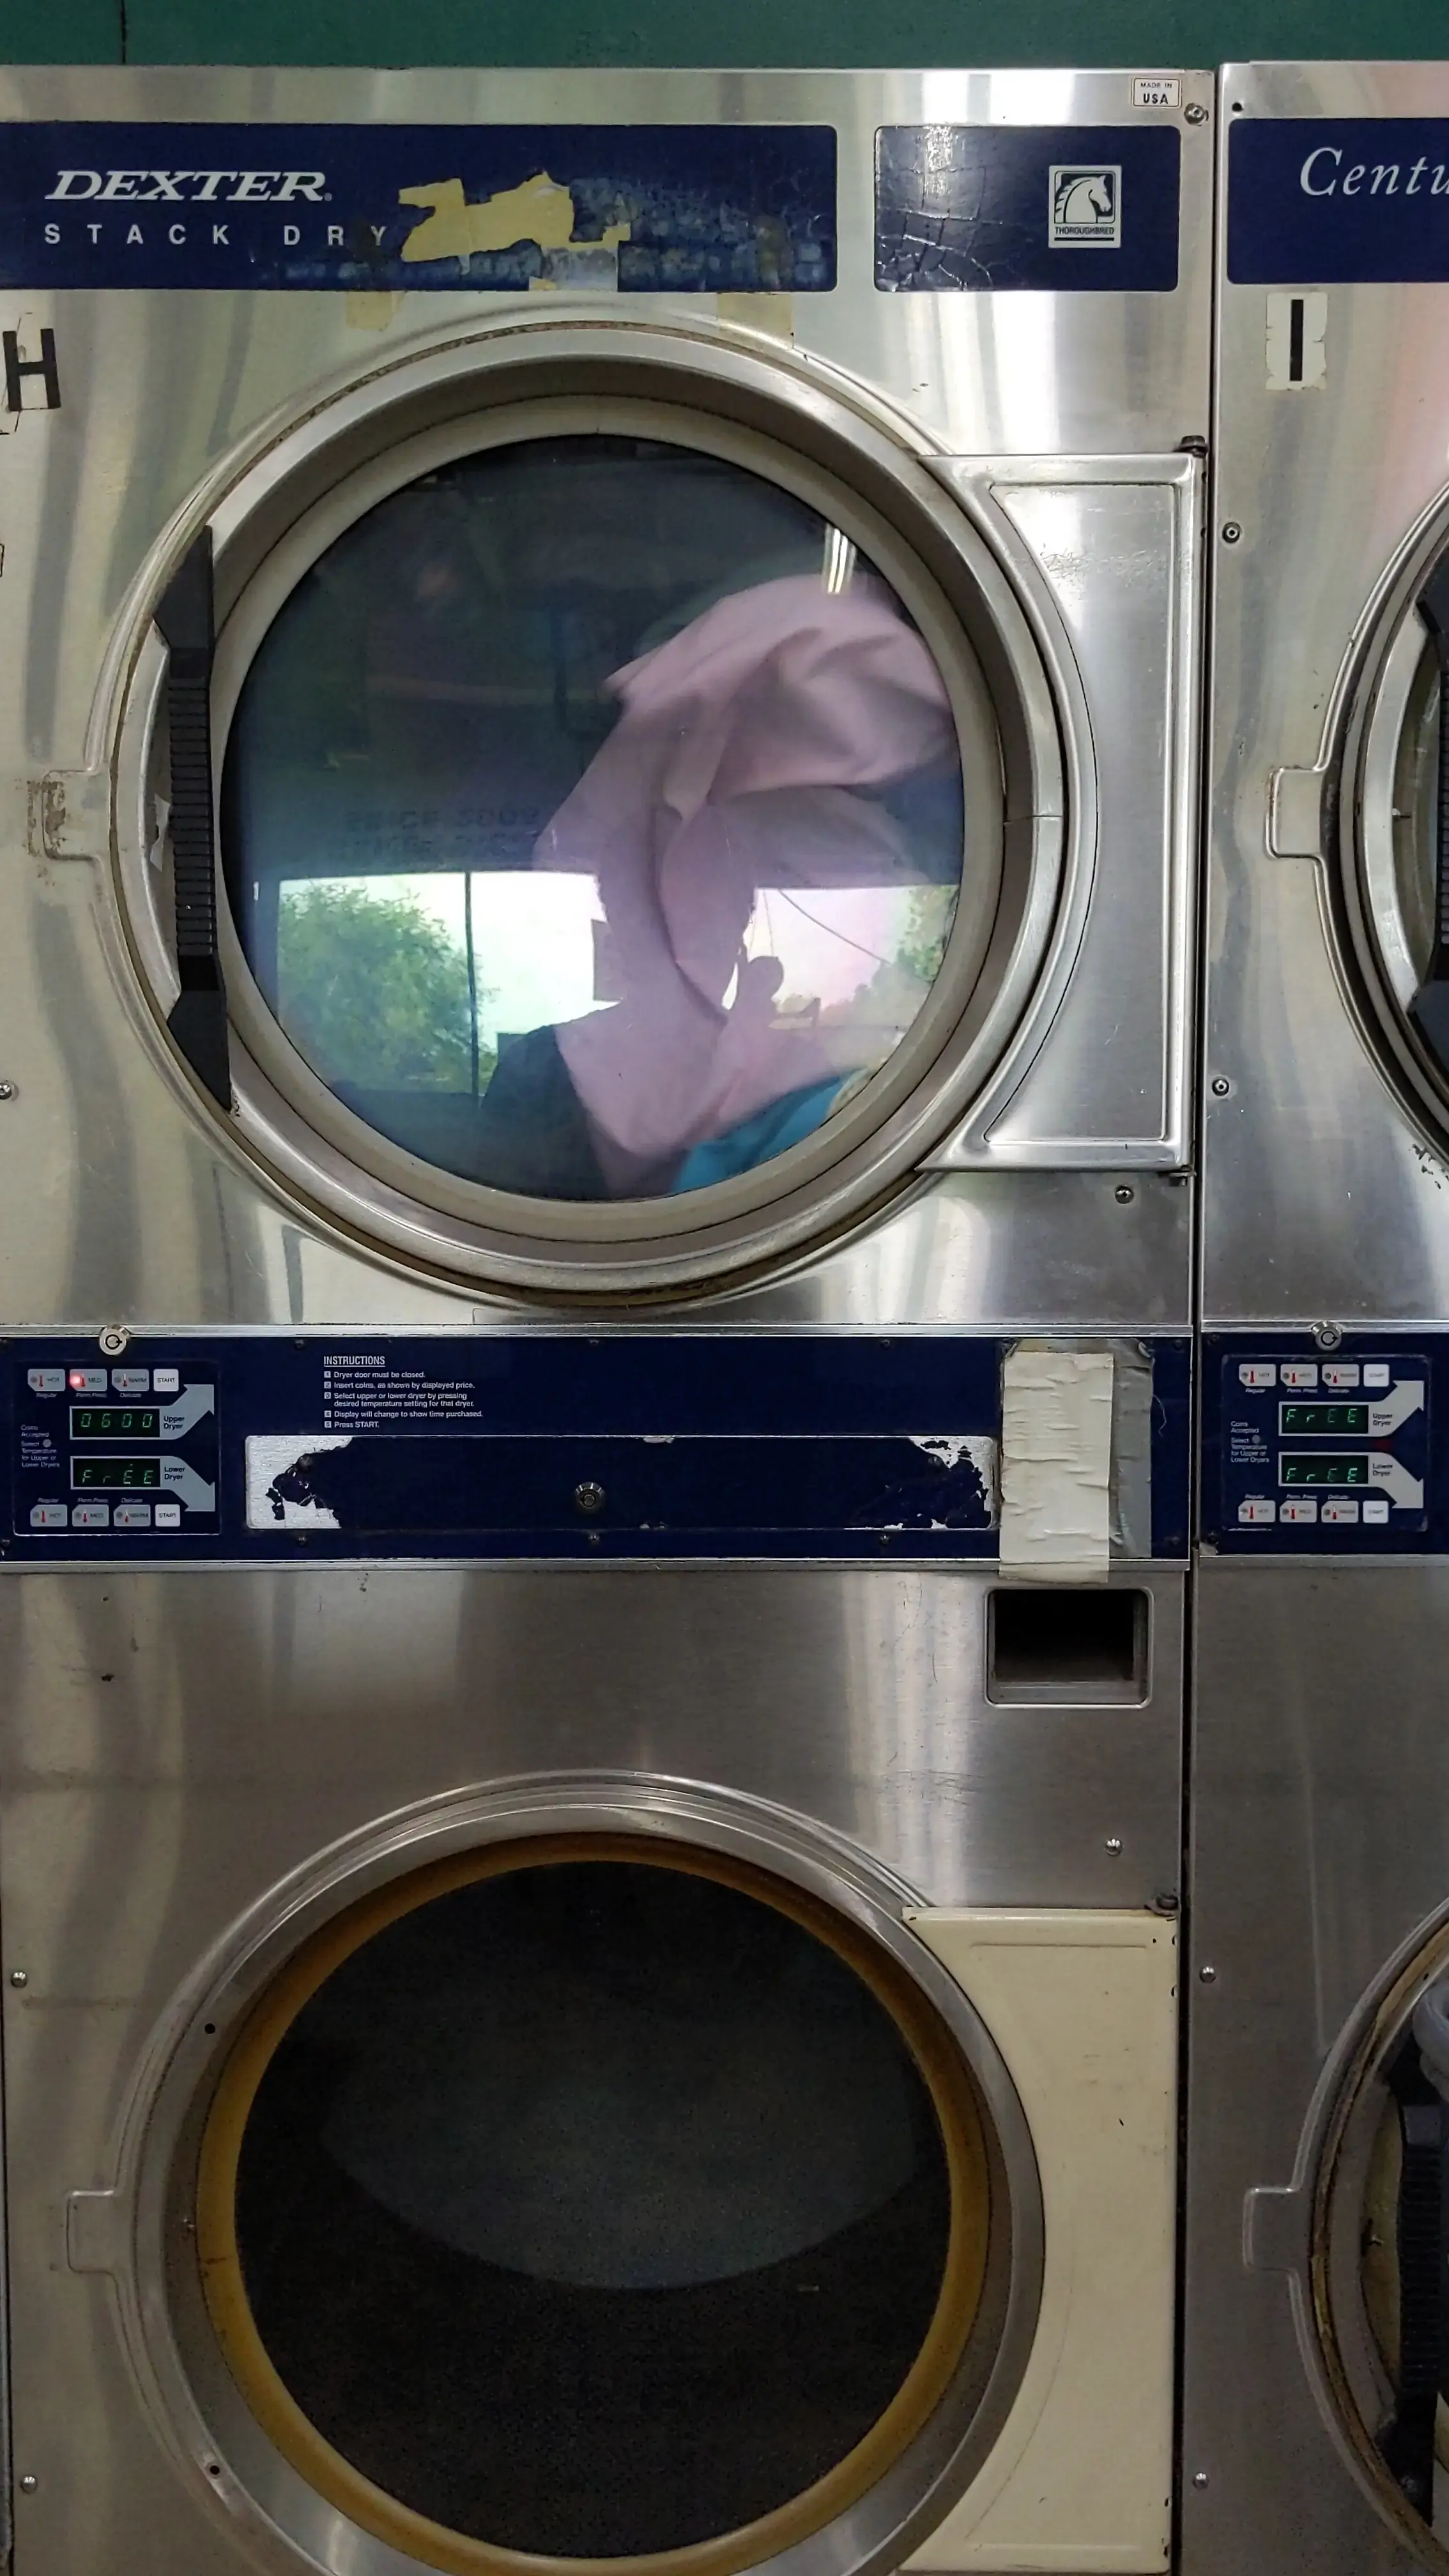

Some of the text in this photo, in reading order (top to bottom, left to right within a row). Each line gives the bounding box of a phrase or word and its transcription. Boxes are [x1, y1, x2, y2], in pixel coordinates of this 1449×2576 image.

[1143, 94, 1169, 104] USA
[45, 224, 387, 246] STACK DRY
[3, 328, 61, 412] H
[324, 1356, 385, 1365] INSTRUCTIONS
